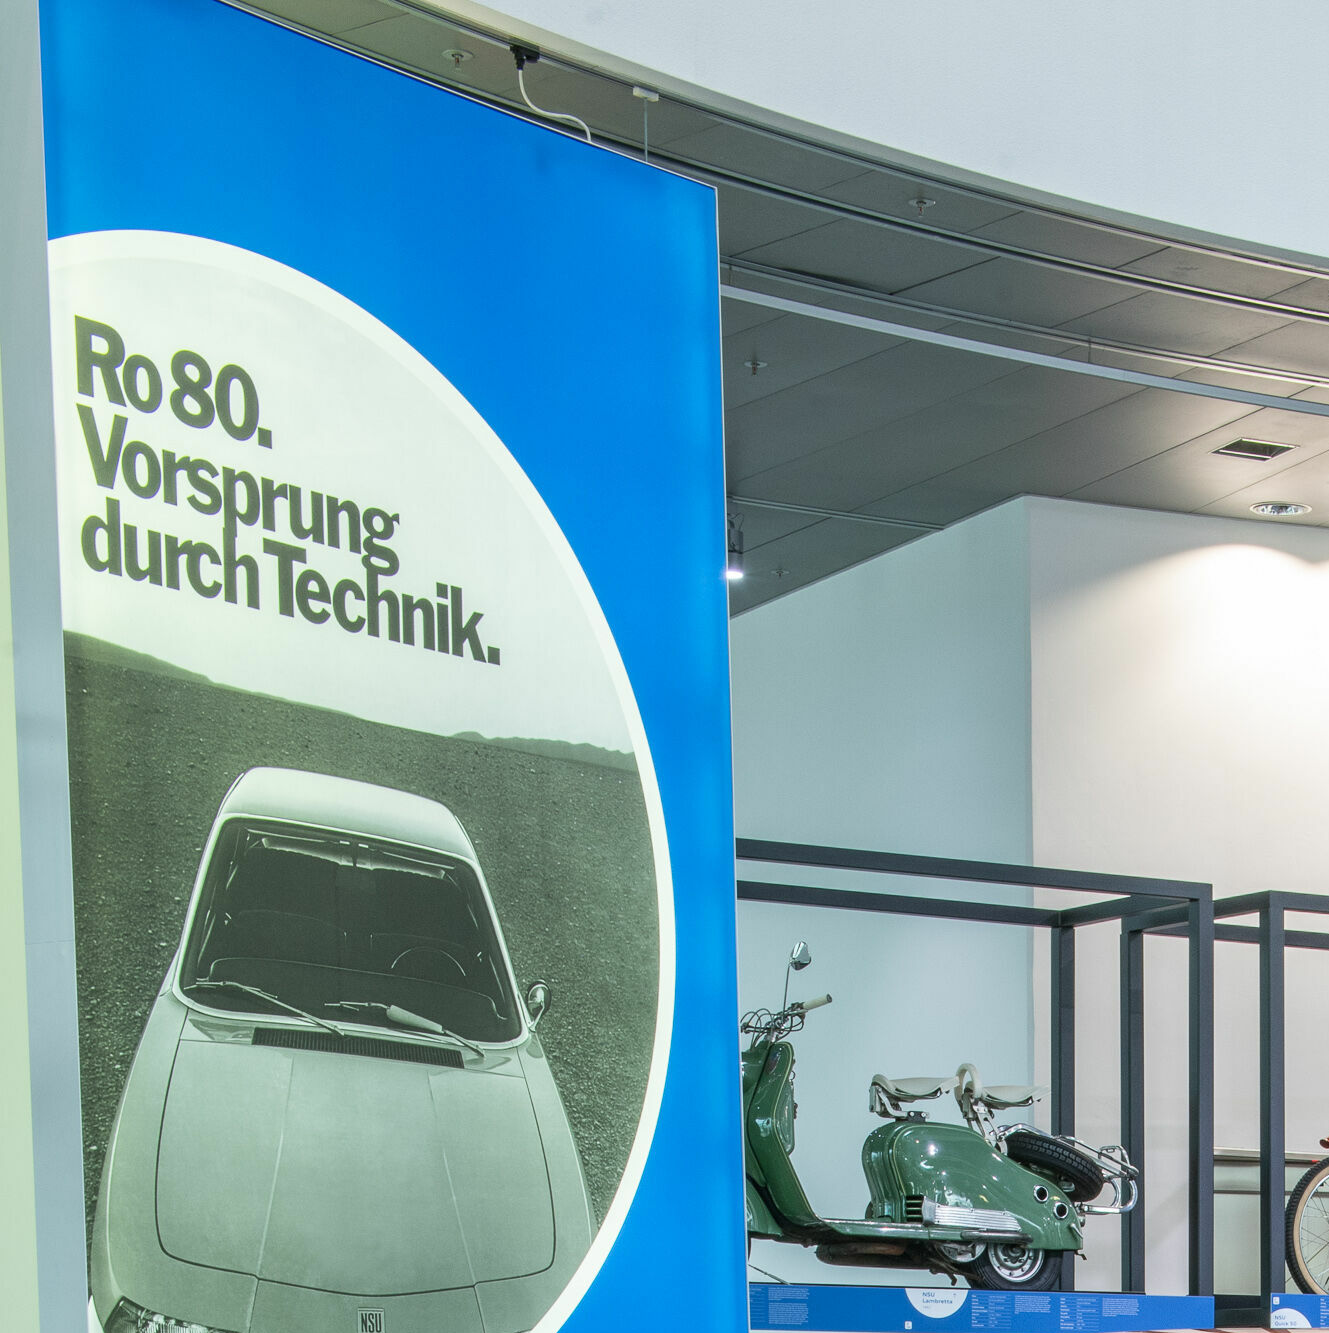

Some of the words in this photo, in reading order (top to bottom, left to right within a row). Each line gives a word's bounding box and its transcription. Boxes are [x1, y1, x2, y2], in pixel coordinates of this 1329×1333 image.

[74, 315, 163, 414] Ro
[169, 350, 273, 449] 80.
[76, 403, 400, 576] Vorsprung
[81, 496, 260, 610] durch
[263, 538, 501, 666] Technik.
[361, 1312, 382, 1333] NSU
